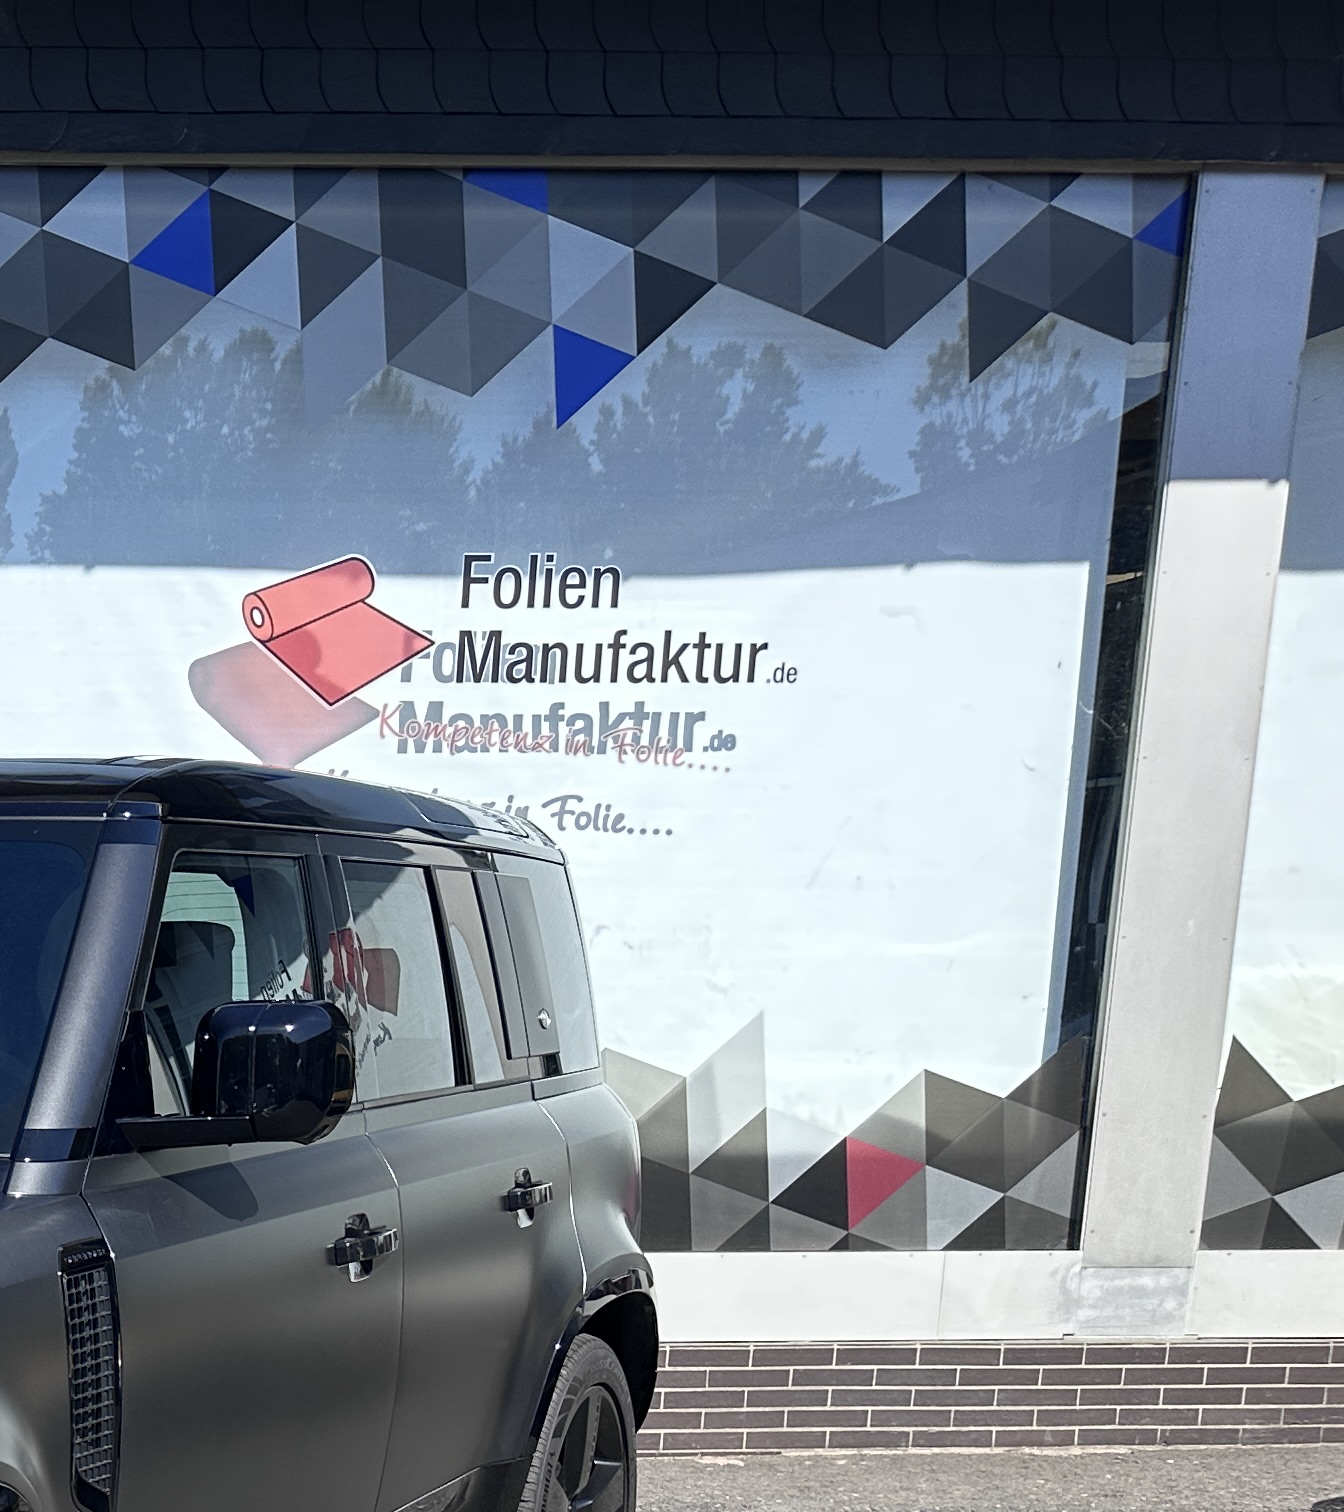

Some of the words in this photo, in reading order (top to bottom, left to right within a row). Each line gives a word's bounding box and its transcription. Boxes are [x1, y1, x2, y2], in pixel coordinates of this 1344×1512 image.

[460, 554, 622, 610] Folien
[455, 629, 798, 684] Manufaktur.de
[378, 702, 555, 757] Kompetenz
[564, 727, 592, 757] in
